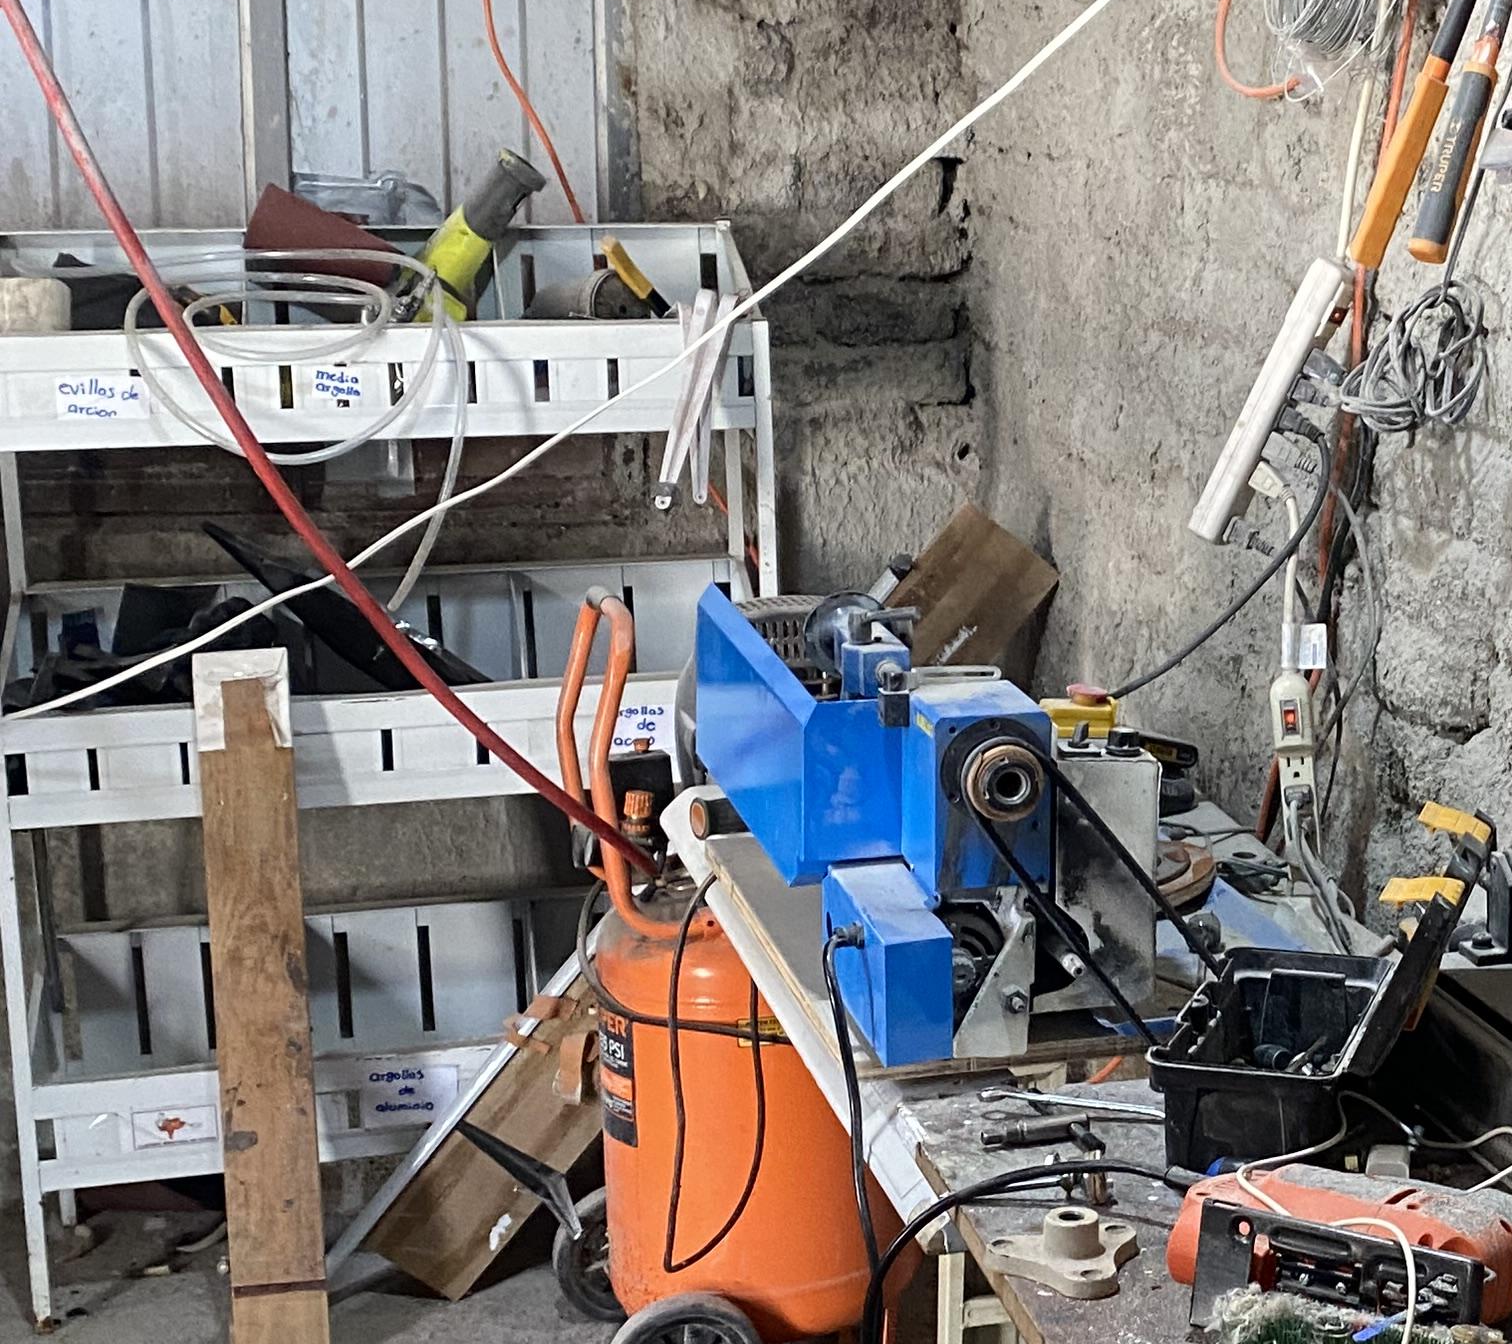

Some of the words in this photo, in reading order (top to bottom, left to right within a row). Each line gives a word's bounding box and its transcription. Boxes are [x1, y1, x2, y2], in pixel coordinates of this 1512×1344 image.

[1430, 135, 1458, 193] TRUPER
[618, 705, 664, 719] rgollas
[613, 735, 655, 747] aco
[608, 1038, 625, 1060] PSI
